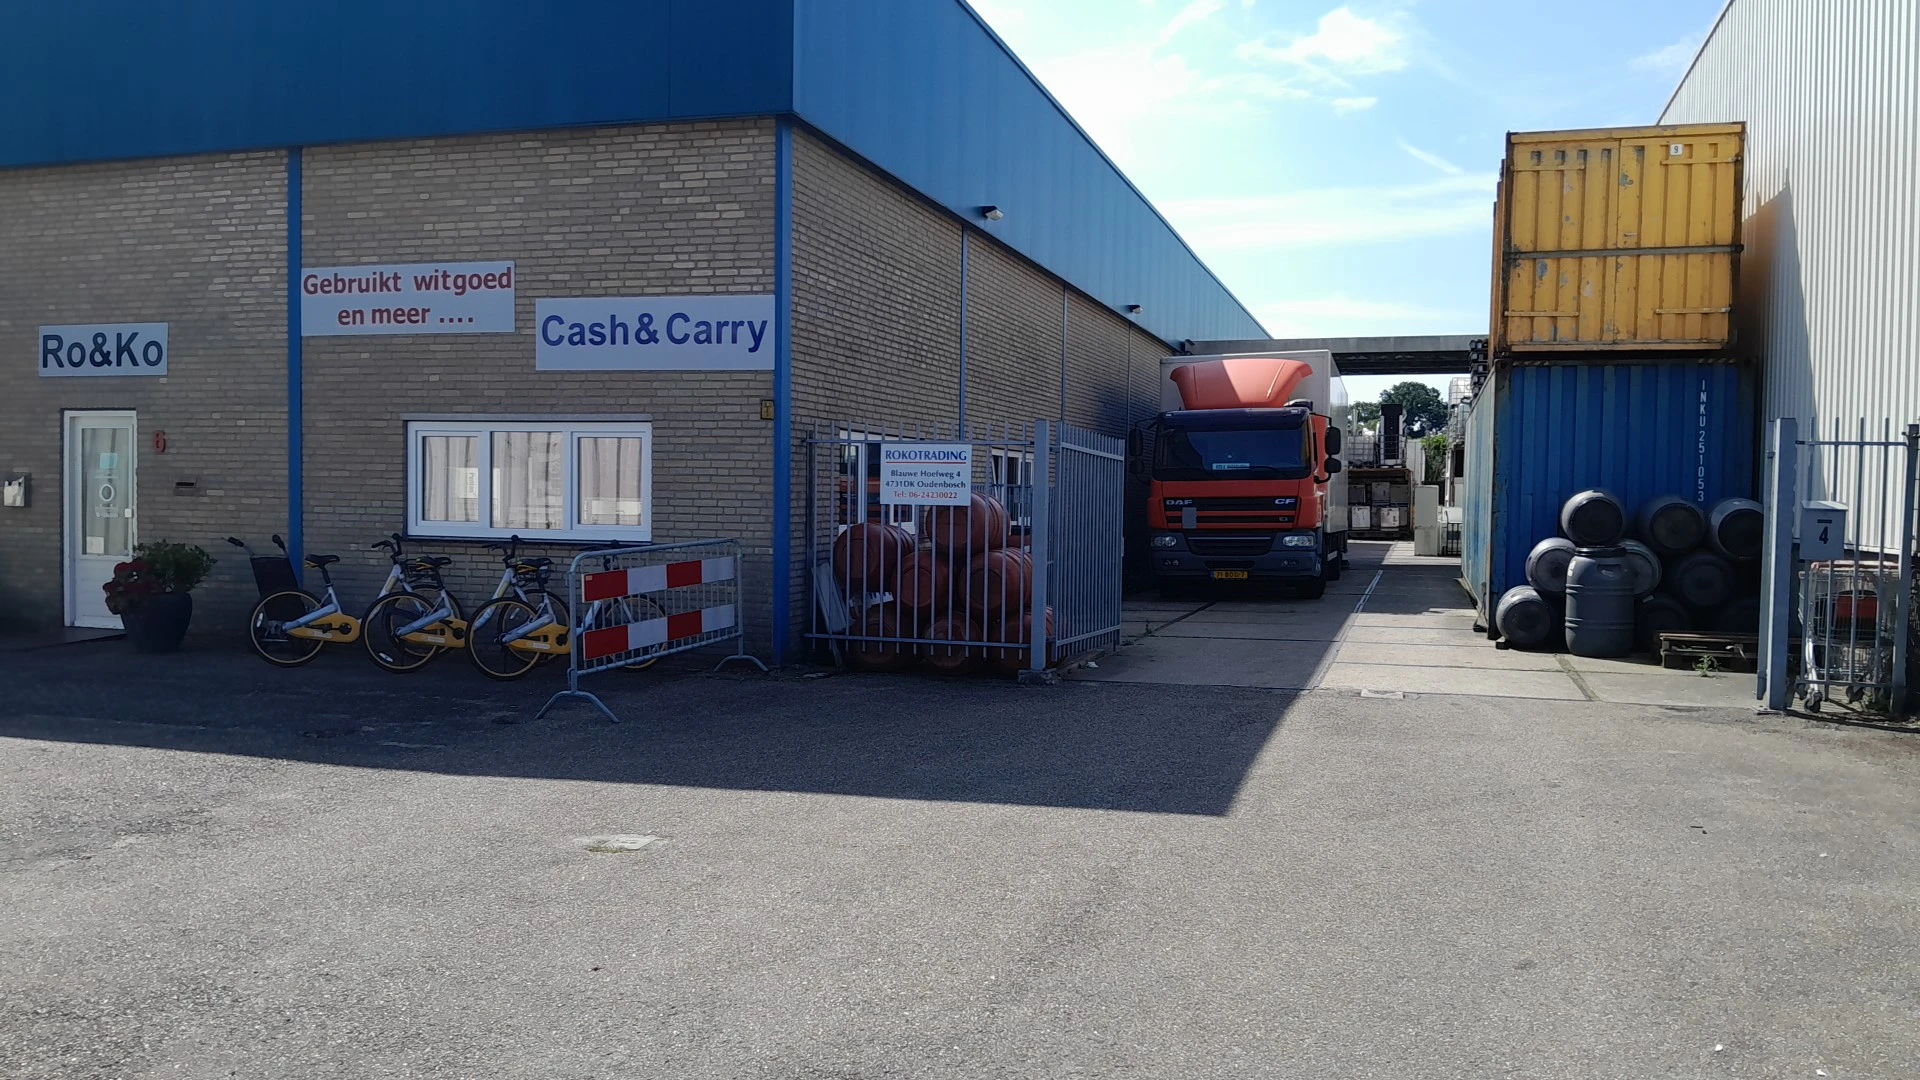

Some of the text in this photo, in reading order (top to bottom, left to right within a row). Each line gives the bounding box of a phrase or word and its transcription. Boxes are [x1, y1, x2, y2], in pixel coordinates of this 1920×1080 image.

[1674, 145, 1679, 153] 9
[303, 266, 512, 296] Gebruikt witgoed
[337, 308, 365, 326] en
[371, 306, 431, 325] meer
[42, 332, 163, 368] Ro&Ko
[152, 430, 166, 455] 6
[885, 450, 967, 461] ROKOTRADING
[890, 469, 961, 479] Blauwe Hoefweg 4
[885, 480, 966, 488] 4731DK Oudenbosch
[908, 491, 958, 499] 06-24230022
[1818, 526, 1829, 545] 4
